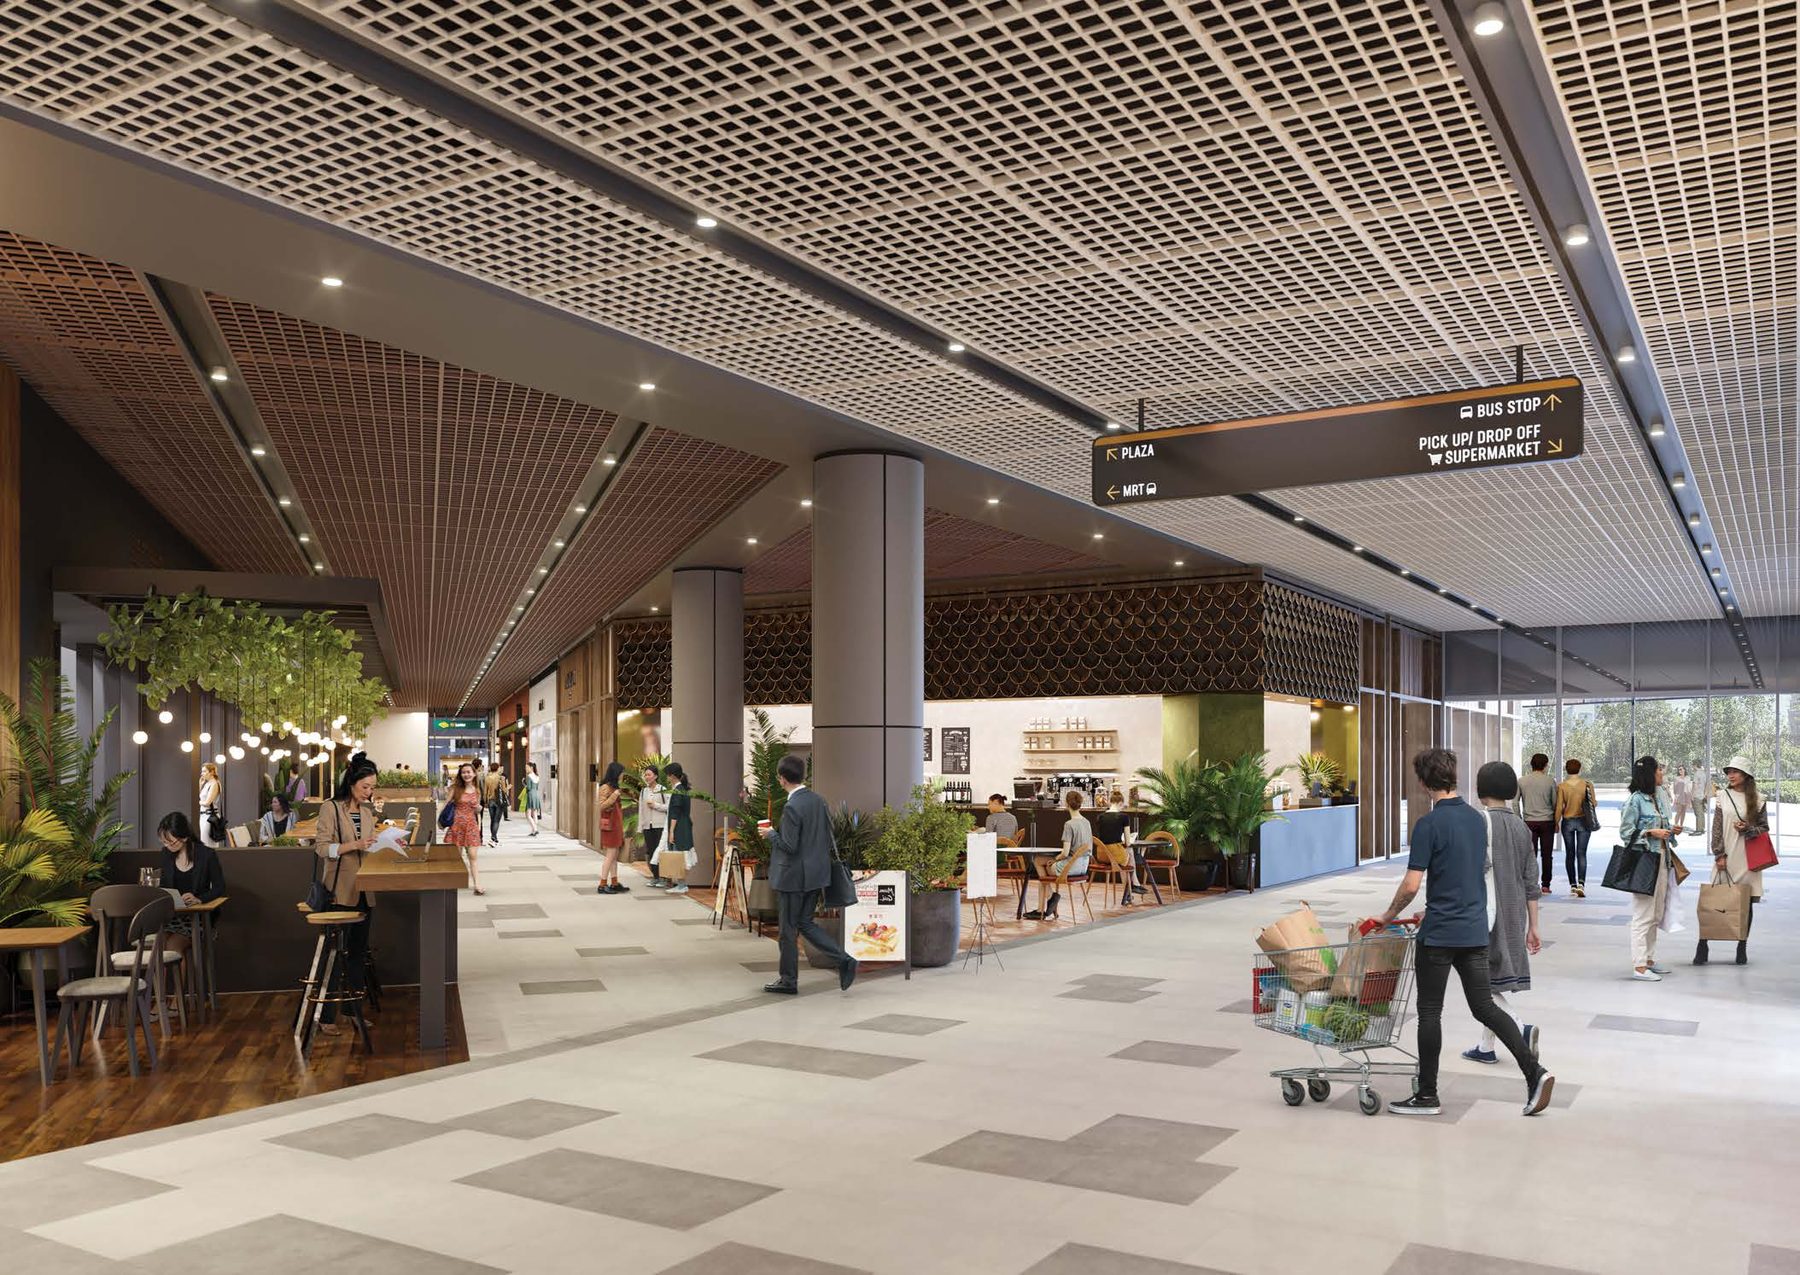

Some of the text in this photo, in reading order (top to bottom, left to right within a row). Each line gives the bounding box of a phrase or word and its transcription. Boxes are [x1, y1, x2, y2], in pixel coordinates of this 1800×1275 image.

[1477, 397, 1541, 418] BUS STOP
[1419, 424, 1541, 450] PICK UP/ DROP OFF
[1122, 444, 1154, 459] PLAZA
[1445, 441, 1541, 464] SUPERMARKET
[1123, 484, 1145, 497] MRT
